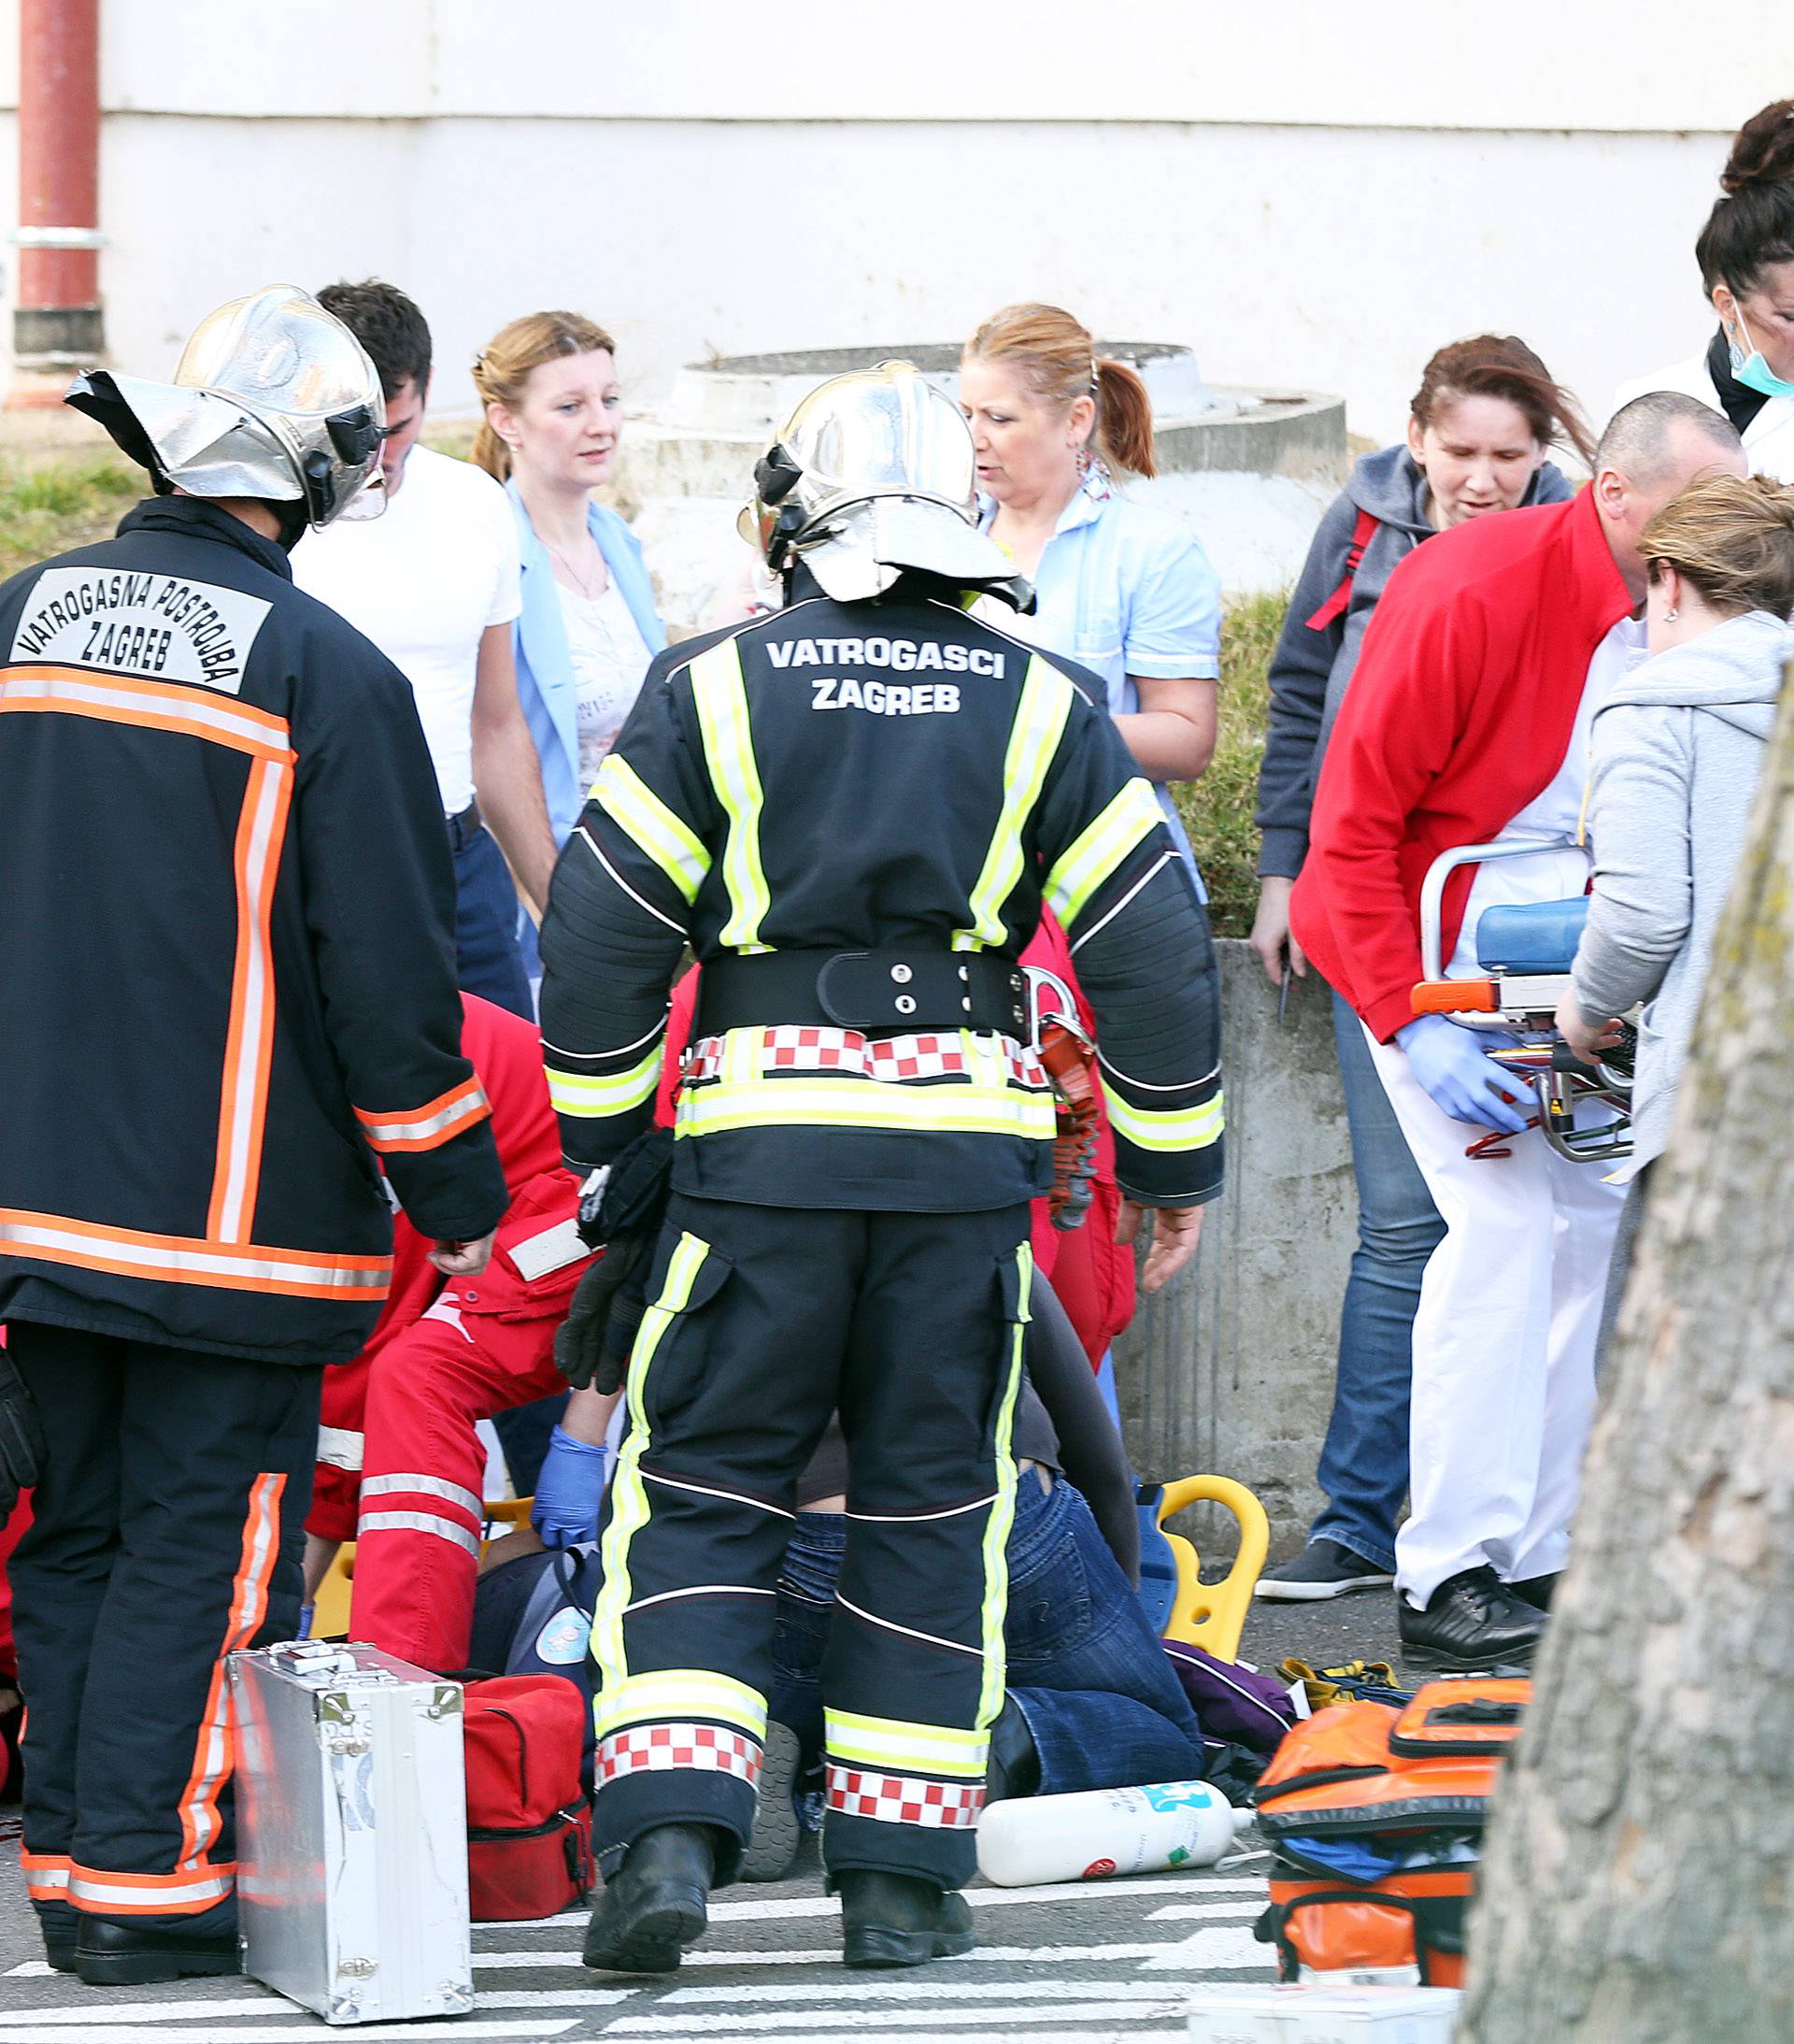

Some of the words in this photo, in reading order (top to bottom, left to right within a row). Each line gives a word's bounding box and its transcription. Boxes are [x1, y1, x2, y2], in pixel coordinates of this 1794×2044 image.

[17, 574, 153, 656] VATROGASNA
[153, 579, 239, 683] POSTROJBA
[81, 621, 172, 672] ZAGREB
[765, 636, 1005, 679] VATROGASCI
[811, 678, 961, 716] ZAGREB
